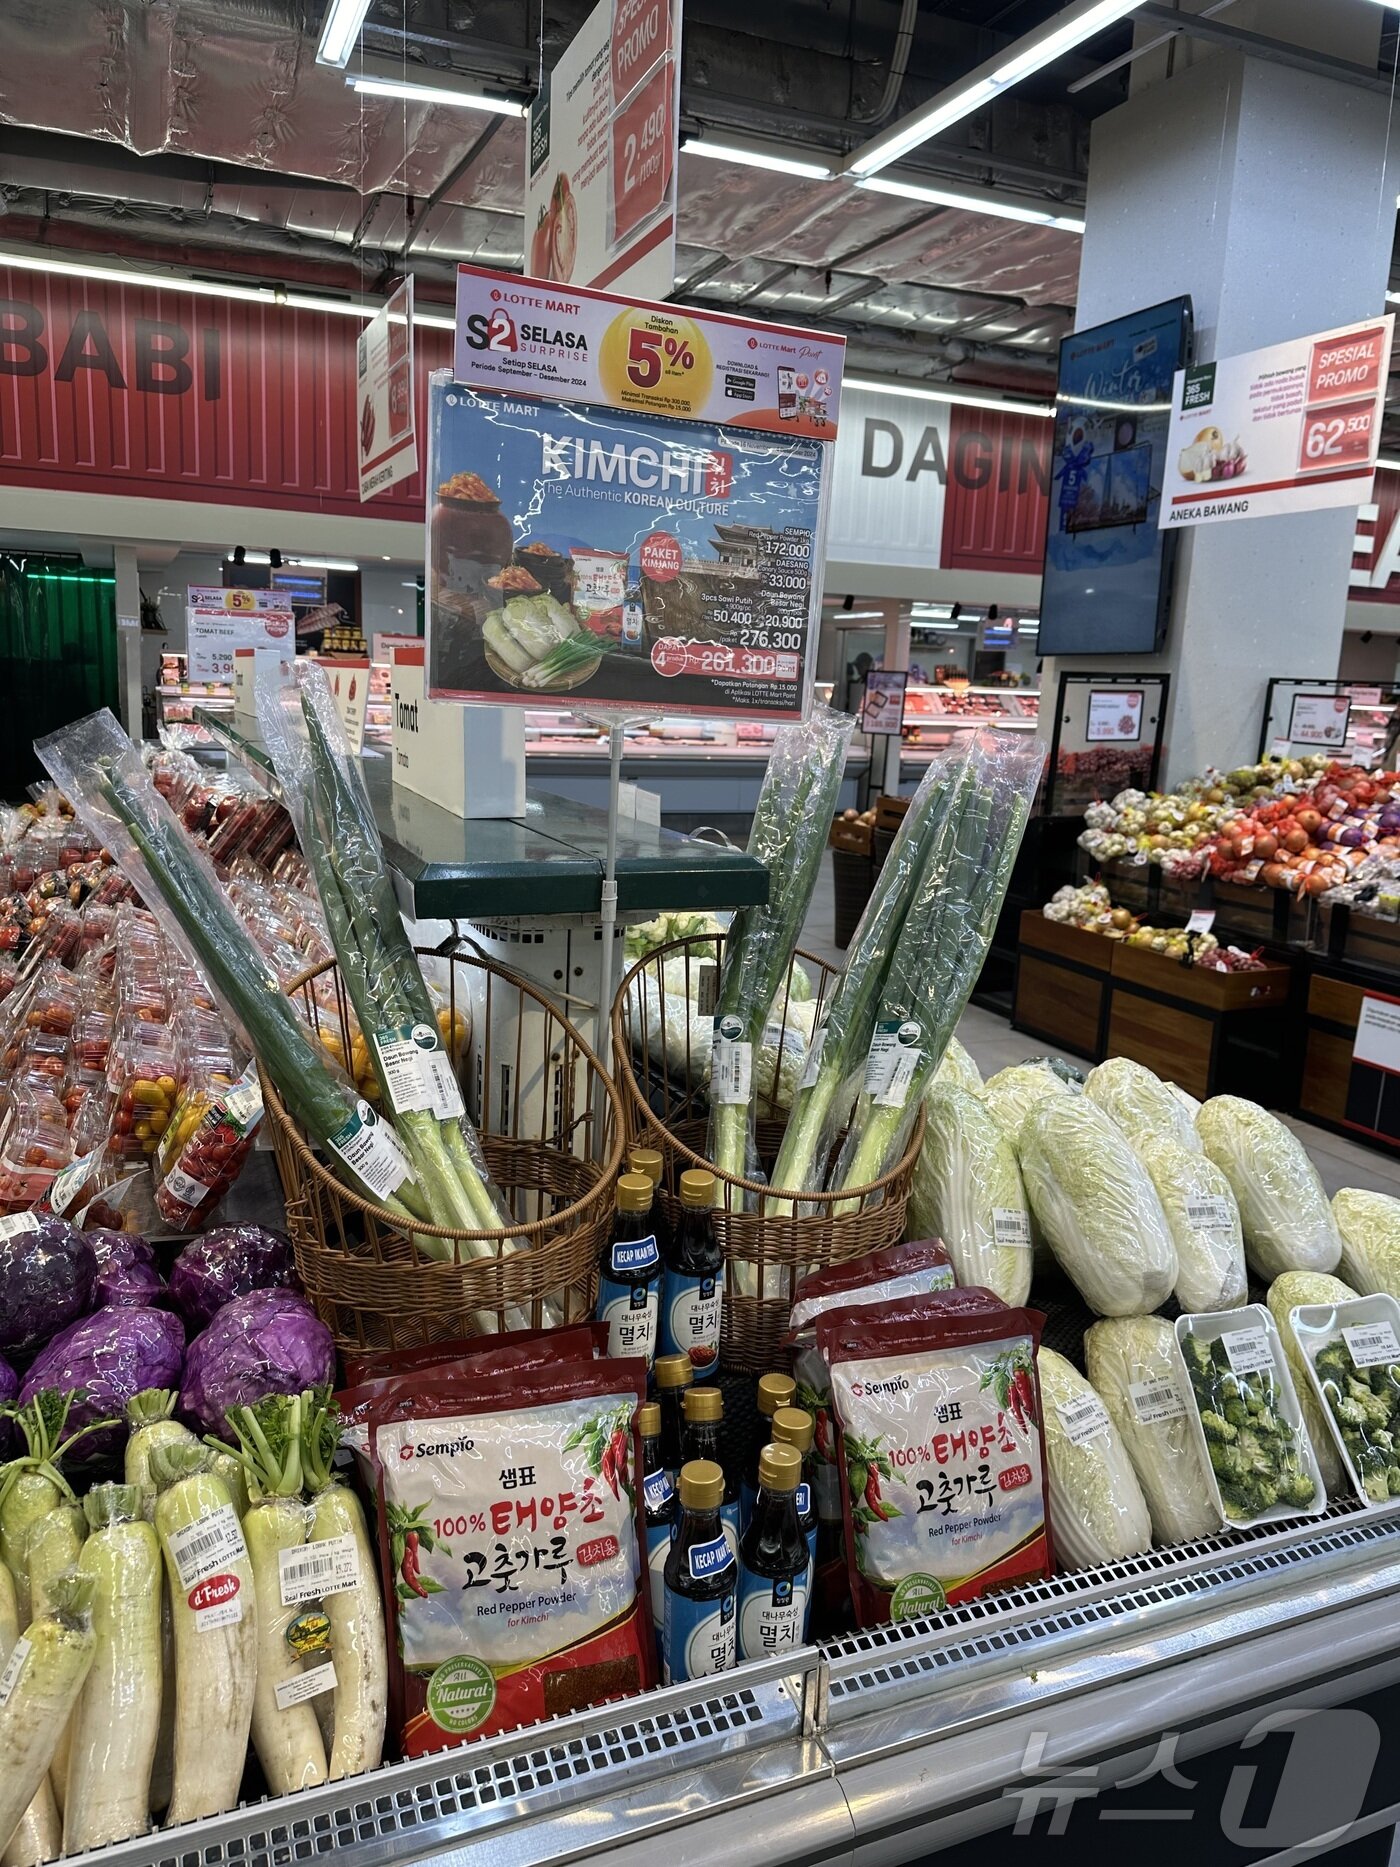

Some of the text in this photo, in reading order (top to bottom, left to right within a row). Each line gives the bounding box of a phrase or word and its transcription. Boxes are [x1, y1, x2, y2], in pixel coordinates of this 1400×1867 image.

[617, 5, 659, 80] PROMO
[503, 293, 581, 316] LOTTE MART
[645, 322, 679, 335] Tambahan
[651, 315, 674, 326] Diskon
[520, 324, 588, 351] SELASA
[759, 342, 780, 351] LOTTE
[780, 345, 796, 354] Mart
[520, 342, 589, 363] SURPRISE
[627, 327, 695, 389] 5%
[1318, 343, 1375, 369] SPESIAL
[471, 361, 587, 387] Periode September Desember 2024
[502, 357, 558, 374] Setiap SELASA
[727, 360, 754, 370] DOWNLOAD
[1316, 365, 1369, 389] PROMO
[1185, 391, 1211, 405] FRESH
[1186, 383, 1201, 395] 365
[460, 396, 540, 417] LOTTE MART
[542, 434, 703, 496] KIMCHI
[565, 484, 729, 517] Authentic KOREAN CULTURE
[1169, 500, 1249, 522] ANEKA BAWANG
[785, 527, 810, 538] SEMPIO
[644, 547, 679, 560] PAKET
[766, 541, 810, 558] 172.000
[642, 558, 680, 571] KIMJANG
[776, 560, 809, 570] DAESANG
[769, 574, 807, 589] 33.000
[701, 593, 753, 605] 3pcs Sawi Putih
[713, 610, 752, 624] 50.400
[765, 614, 803, 629] 20.900
[195, 627, 218, 635] TOMAT
[740, 629, 801, 650] 276.300
[655, 650, 667, 667] 4
[395, 692, 419, 734] Tomat
[617, 1250, 634, 1263] KECAP
[689, 1310, 718, 1335] 멸치
[619, 1322, 650, 1346] 멸치
[864, 1375, 909, 1396] Sempio
[933, 1402, 963, 1424] 샘표
[416, 1436, 475, 1459] Sempio
[888, 1412, 1017, 1468] 100% 태양초
[498, 1465, 537, 1490] 샘표
[916, 1464, 998, 1516] 고춧가루
[433, 1476, 605, 1539] 100% 태양초
[928, 1514, 1003, 1538] Red Pepper Powder
[951, 1533, 983, 1546] for Kimchi
[579, 1539, 618, 1563] 김치용
[694, 1550, 715, 1570] KECAP
[196, 1559, 219, 1576] Fresh
[219, 1551, 237, 1563] LOTTE
[461, 1536, 575, 1593] 고춧가루
[300, 1588, 321, 1599] Fresh
[322, 1584, 340, 1593] LOTTE
[341, 1580, 357, 1588] Mart
[477, 1591, 577, 1617] Red Pepper Powder
[898, 1596, 941, 1616] Natural
[507, 1612, 550, 1628] for Kimchi
[760, 1621, 796, 1648] 멸치
[454, 1671, 467, 1681] All
[436, 1683, 489, 1704] Natural
